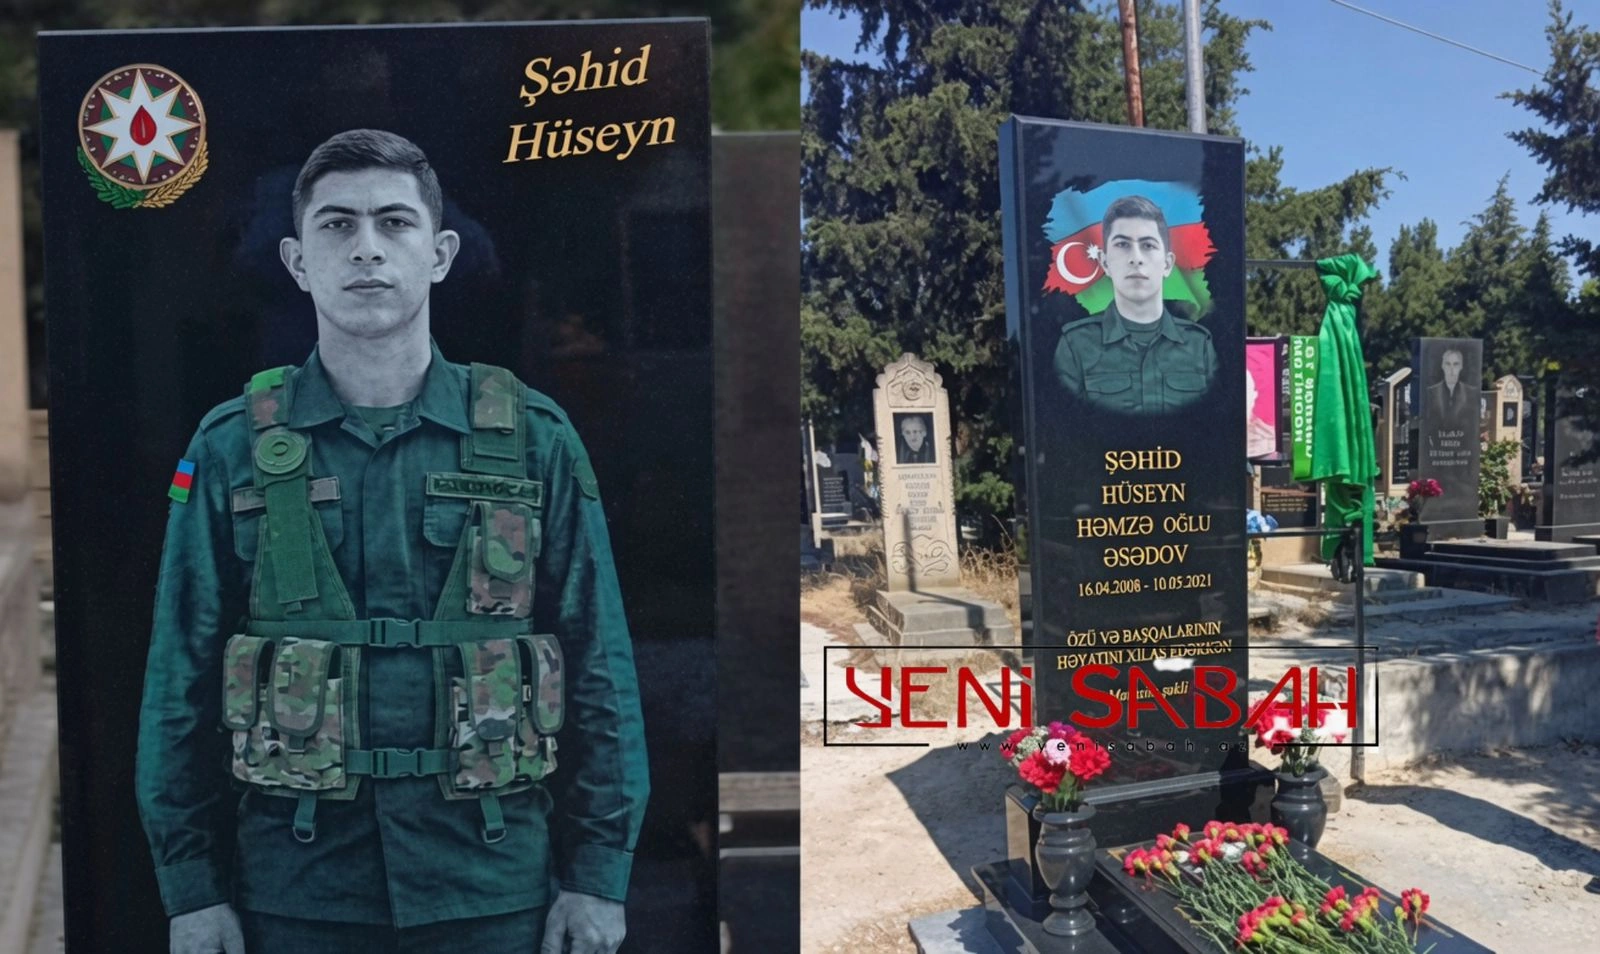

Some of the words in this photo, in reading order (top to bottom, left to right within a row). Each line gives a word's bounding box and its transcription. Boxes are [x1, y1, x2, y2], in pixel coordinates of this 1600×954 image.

[519, 43, 652, 108] Şəhid
[502, 115, 676, 164] Hüseyn
[1104, 446, 1182, 476] ŞƏHİD
[1101, 480, 1186, 505] HÜSEYN
[1076, 515, 1154, 538] HƏMZƏ
[1163, 512, 1211, 534] OĞLU
[1103, 544, 1189, 568] ƏSƏDOV
[1067, 628, 1097, 648] ÖZÜ
[1099, 630, 1120, 645] VƏ
[1122, 620, 1222, 644] BAŞQALARININ
